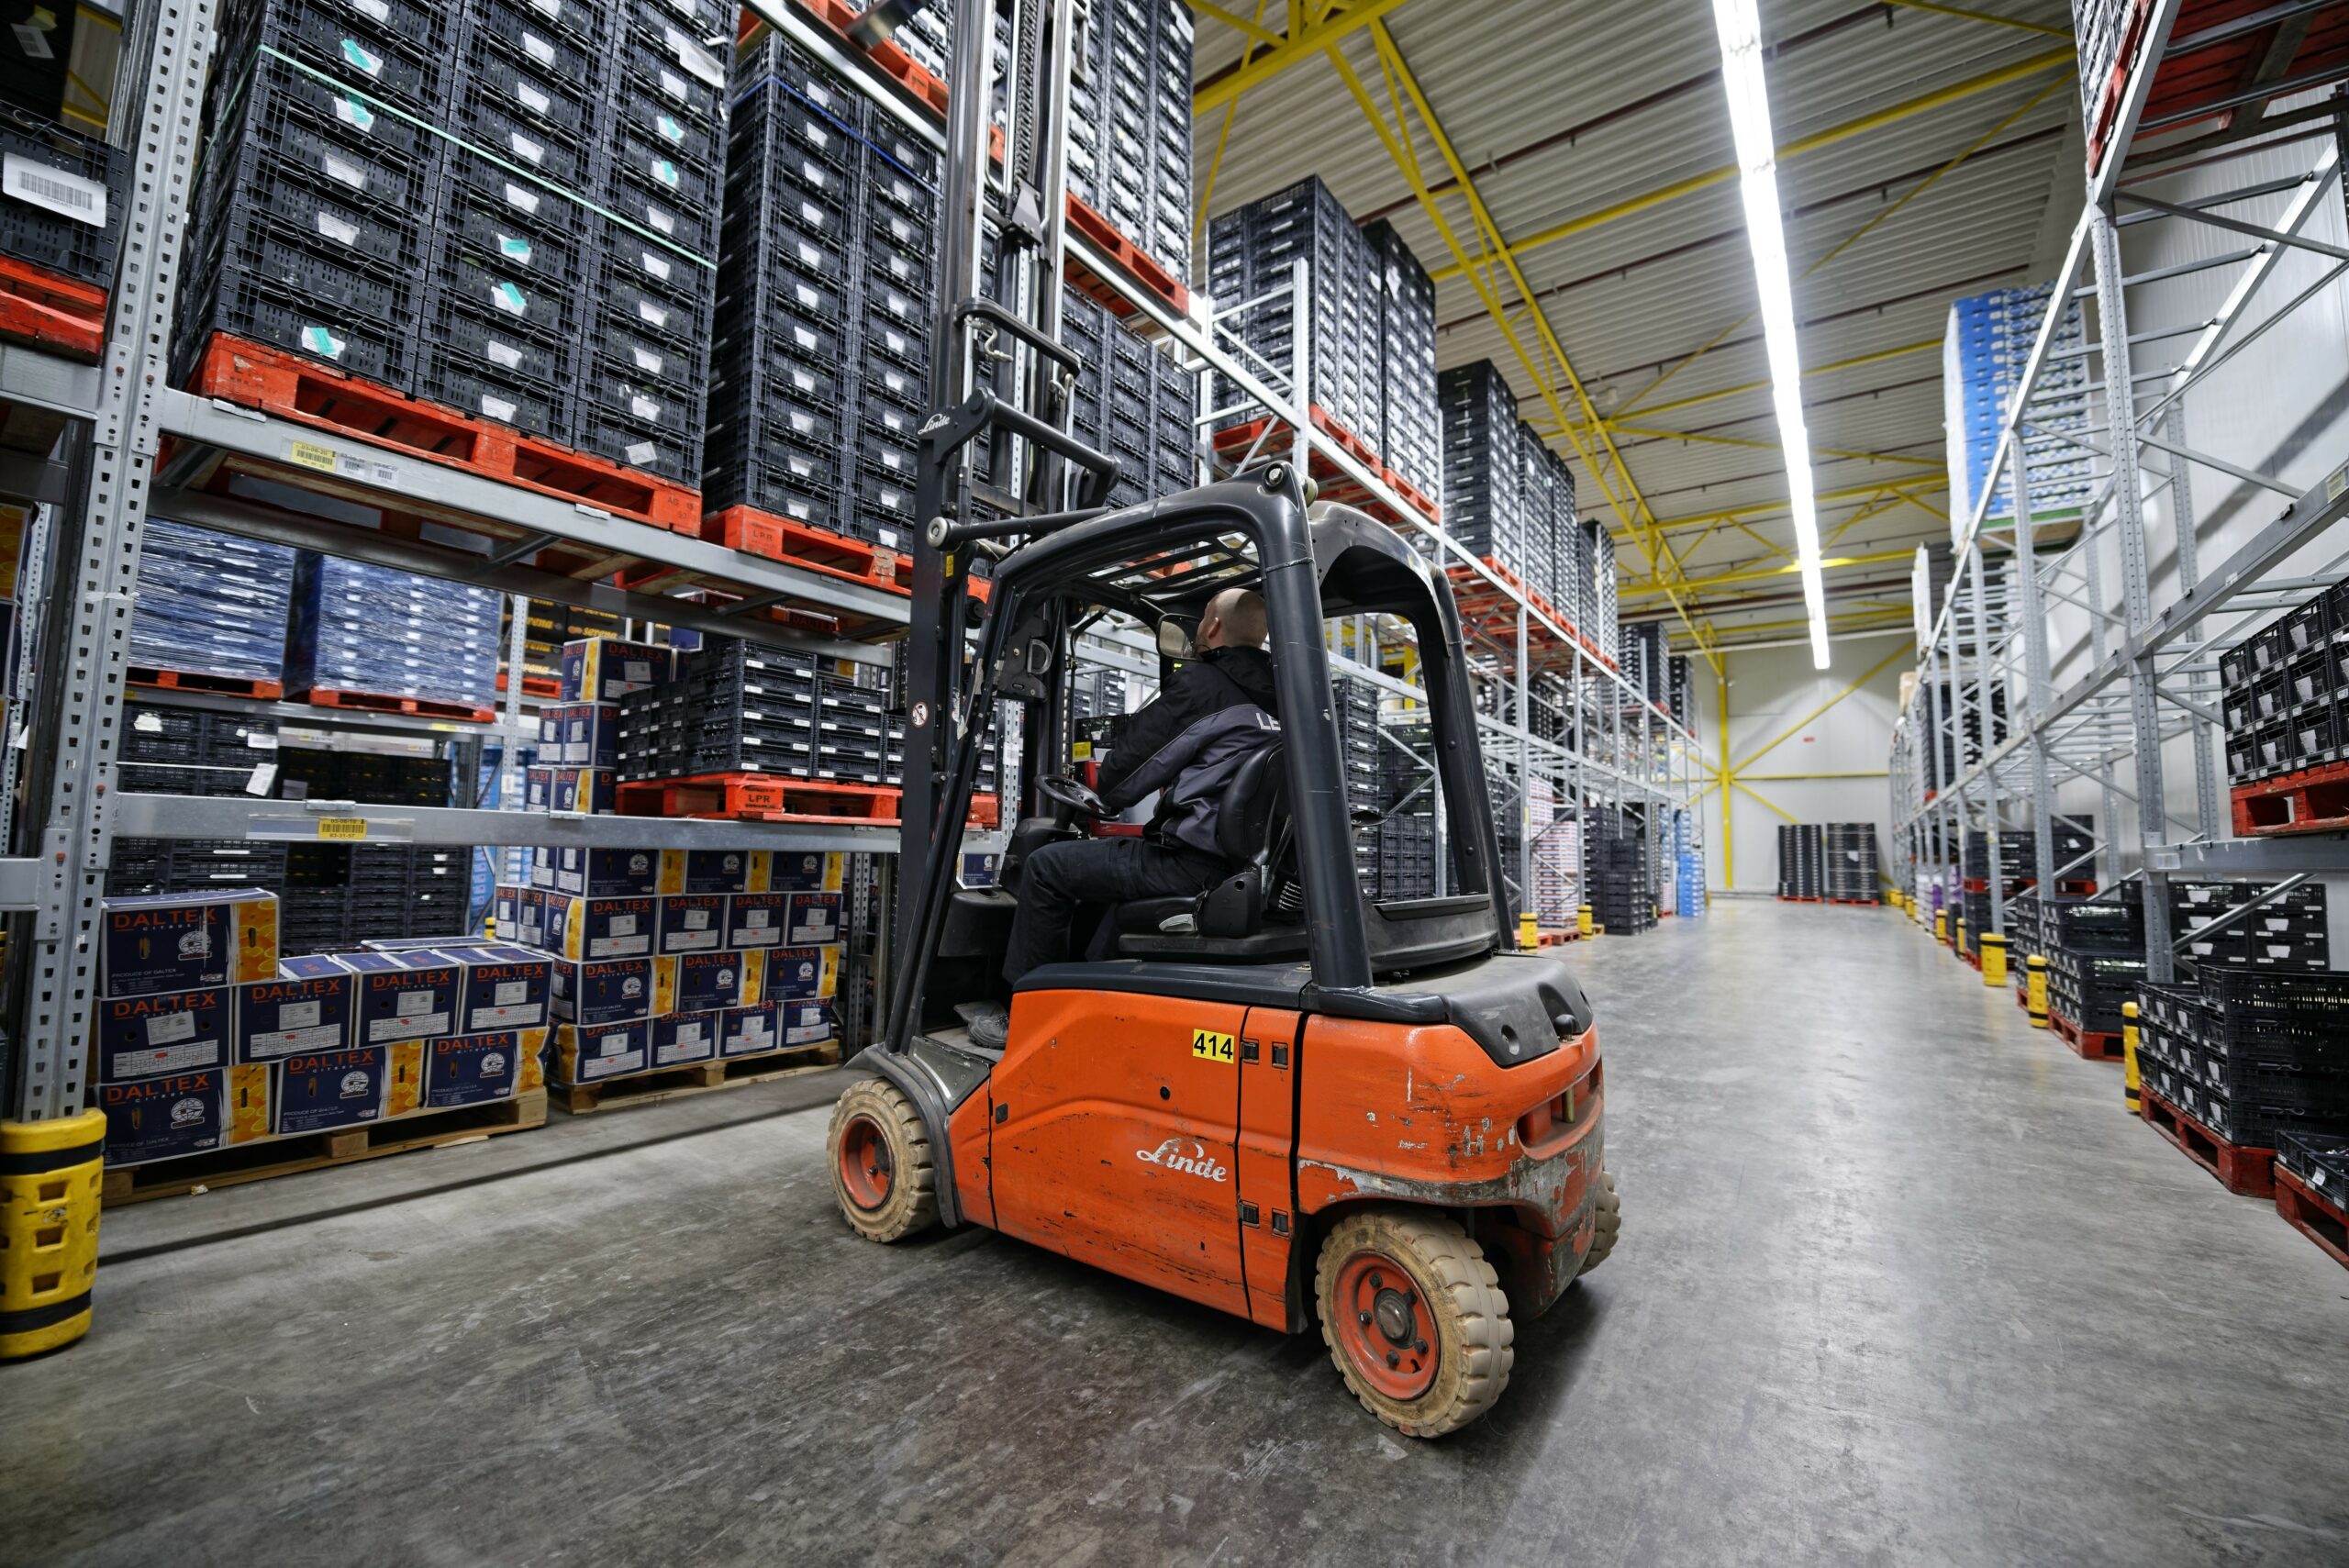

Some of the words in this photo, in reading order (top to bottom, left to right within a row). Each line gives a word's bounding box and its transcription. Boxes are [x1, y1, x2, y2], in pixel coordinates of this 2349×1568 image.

[918, 413, 951, 435] Linde
[753, 530, 774, 541] LPR
[564, 643, 585, 656] DALTEX
[608, 643, 664, 660] DALTEX
[749, 795, 771, 803] LPR
[594, 899, 650, 912] DALTEX
[669, 897, 719, 908] DALTEX
[736, 895, 782, 906] DALTEX
[796, 895, 837, 905] DALTEX
[114, 907, 218, 929] DALTEX
[685, 954, 735, 967] DALTEX
[773, 949, 815, 959] DALTEX
[477, 964, 544, 979] DALTEX
[586, 960, 644, 976] DALTEX
[373, 971, 450, 988] DALTEX
[252, 979, 340, 1000] DALTEX
[114, 992, 217, 1017] DALTEX
[438, 1034, 508, 1052] DALTEX
[1194, 1033, 1233, 1060] 414
[290, 1050, 374, 1071] DALTEX
[107, 1073, 209, 1102] DALTEX
[1136, 1138, 1227, 1182] Linde
